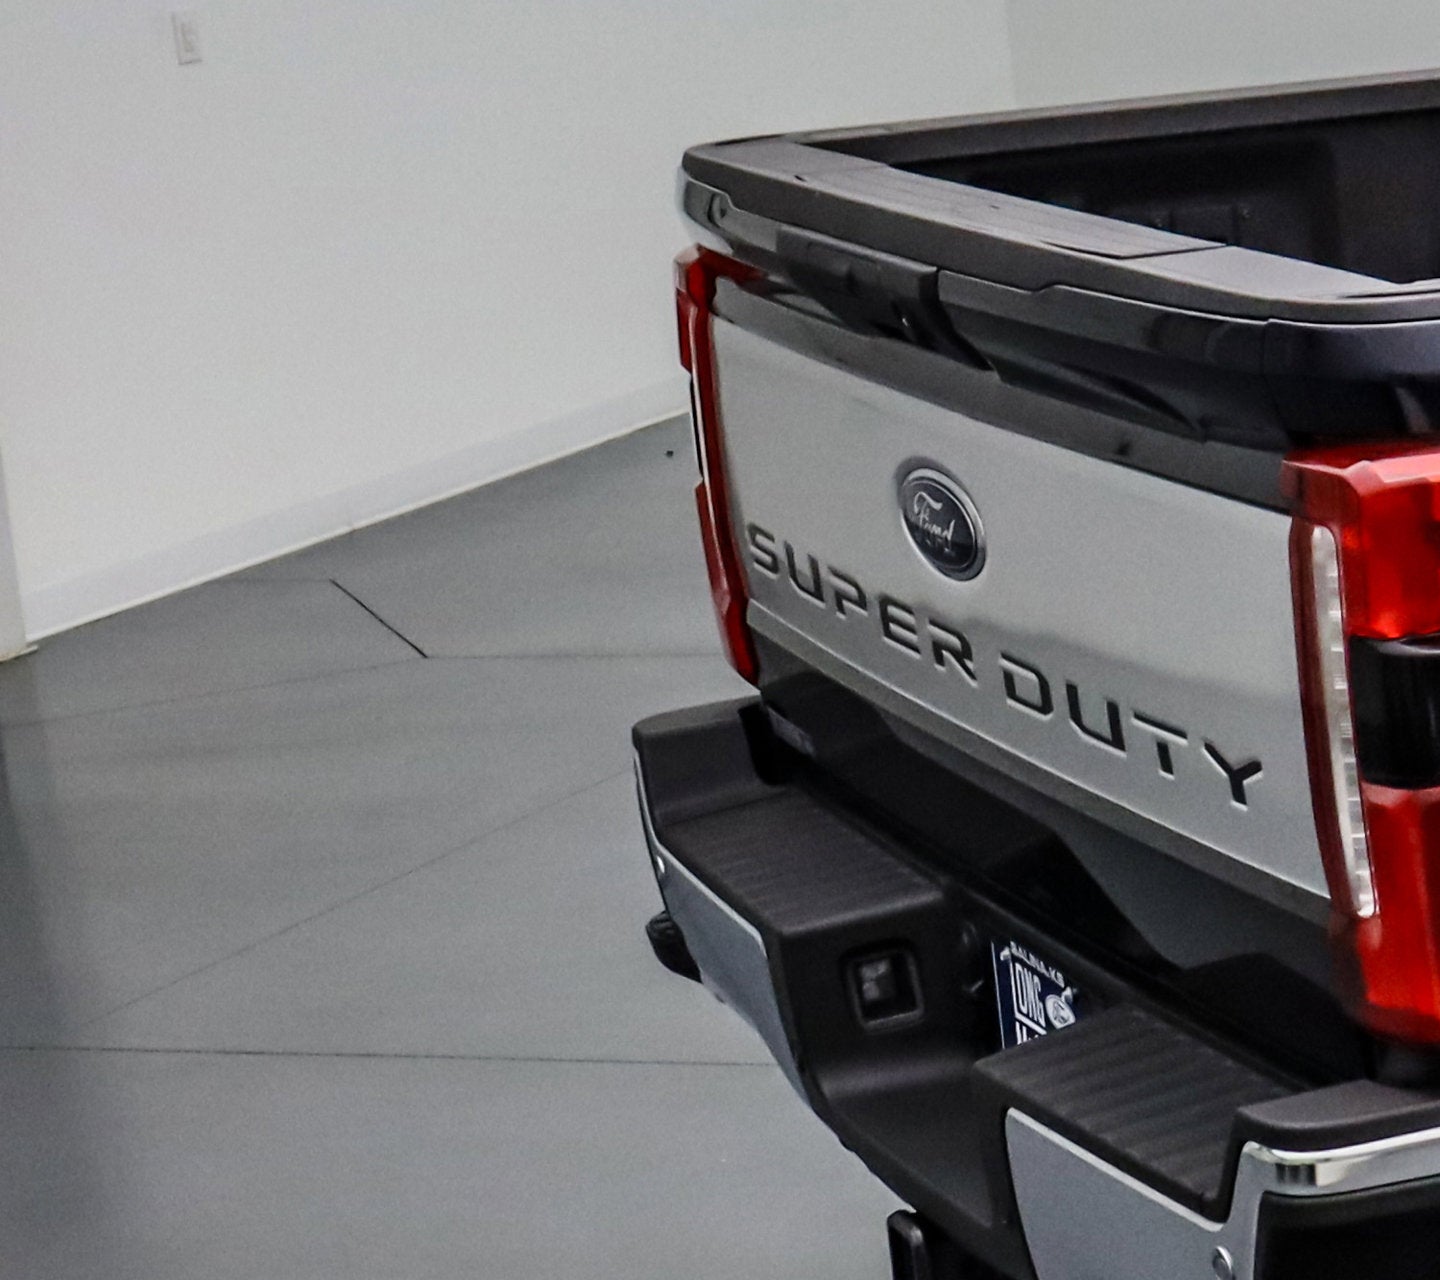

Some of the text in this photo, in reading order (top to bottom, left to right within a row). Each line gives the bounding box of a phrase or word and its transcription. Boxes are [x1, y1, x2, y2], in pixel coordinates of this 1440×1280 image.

[912, 489, 957, 550] Ford
[747, 523, 1264, 811] SUPER DUTY
